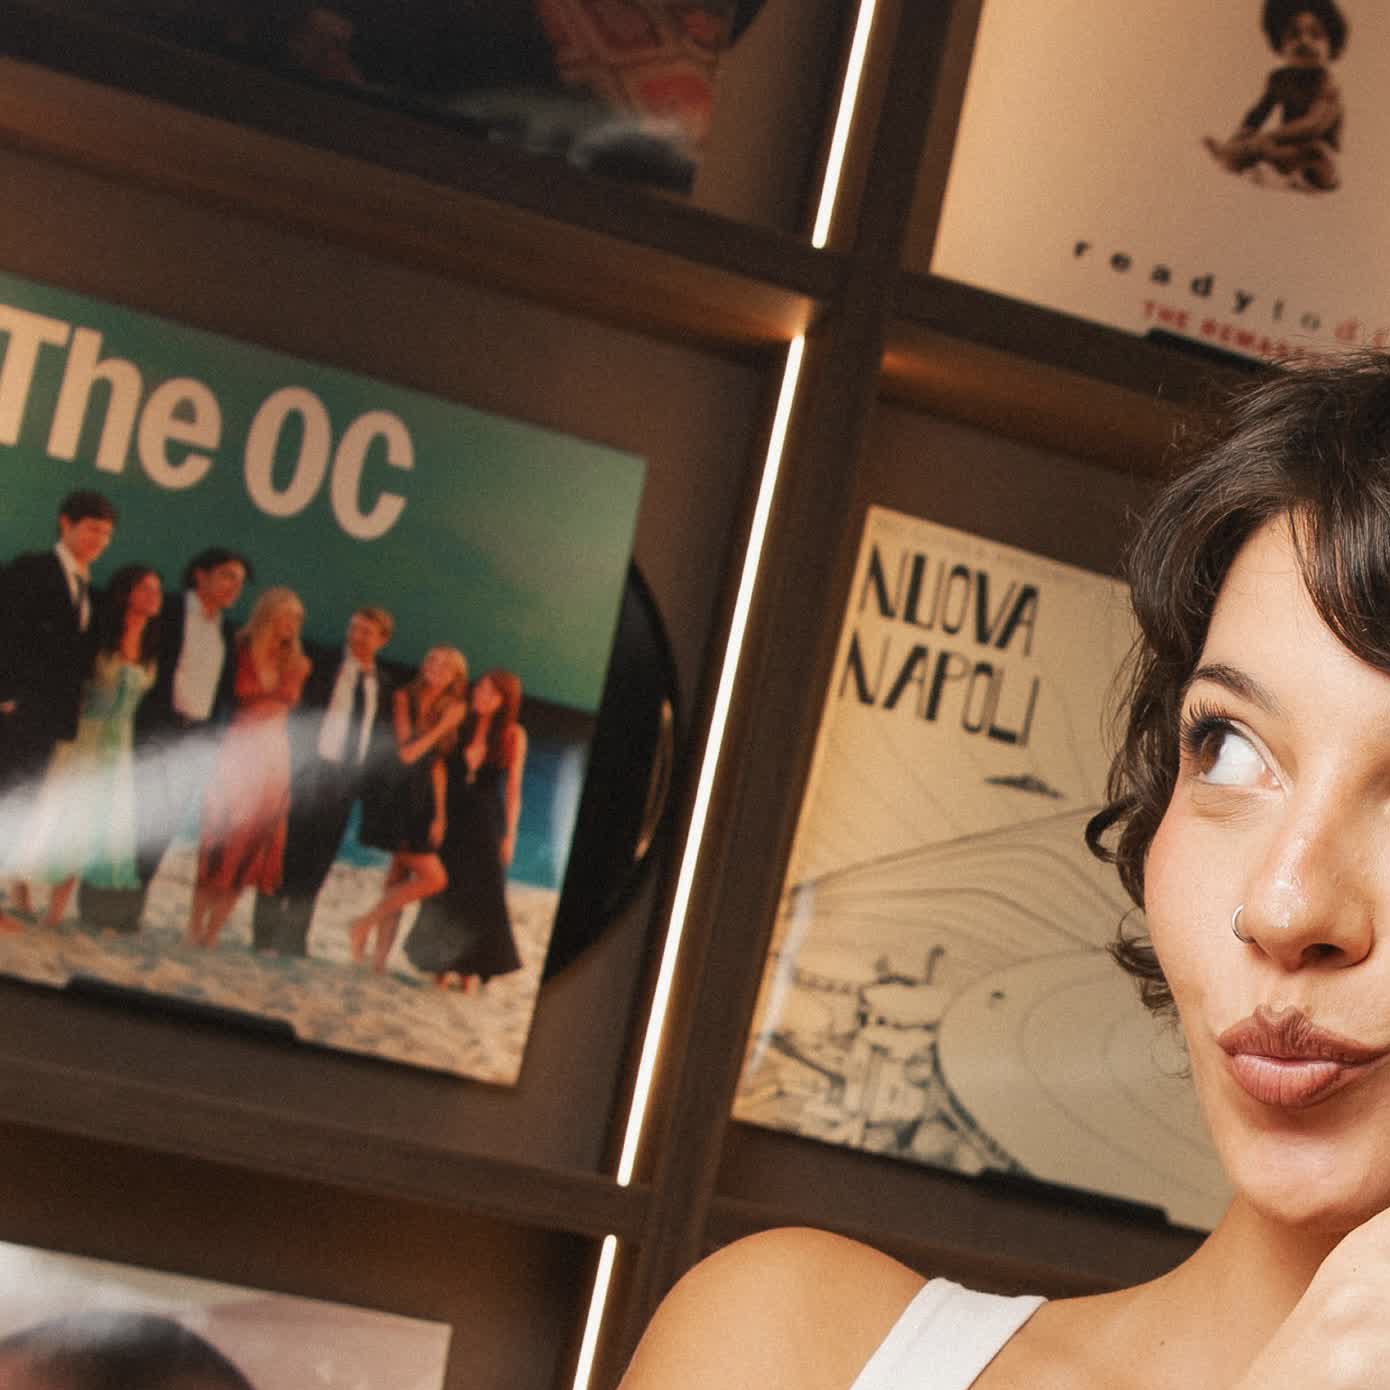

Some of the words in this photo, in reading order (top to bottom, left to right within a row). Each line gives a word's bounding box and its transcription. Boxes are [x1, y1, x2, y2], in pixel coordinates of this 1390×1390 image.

[1073, 240, 1254, 316] ready
[0, 303, 222, 491] The
[242, 385, 415, 542] OC
[859, 543, 1039, 657] NUOVA
[839, 627, 1041, 748] NAPOLI
